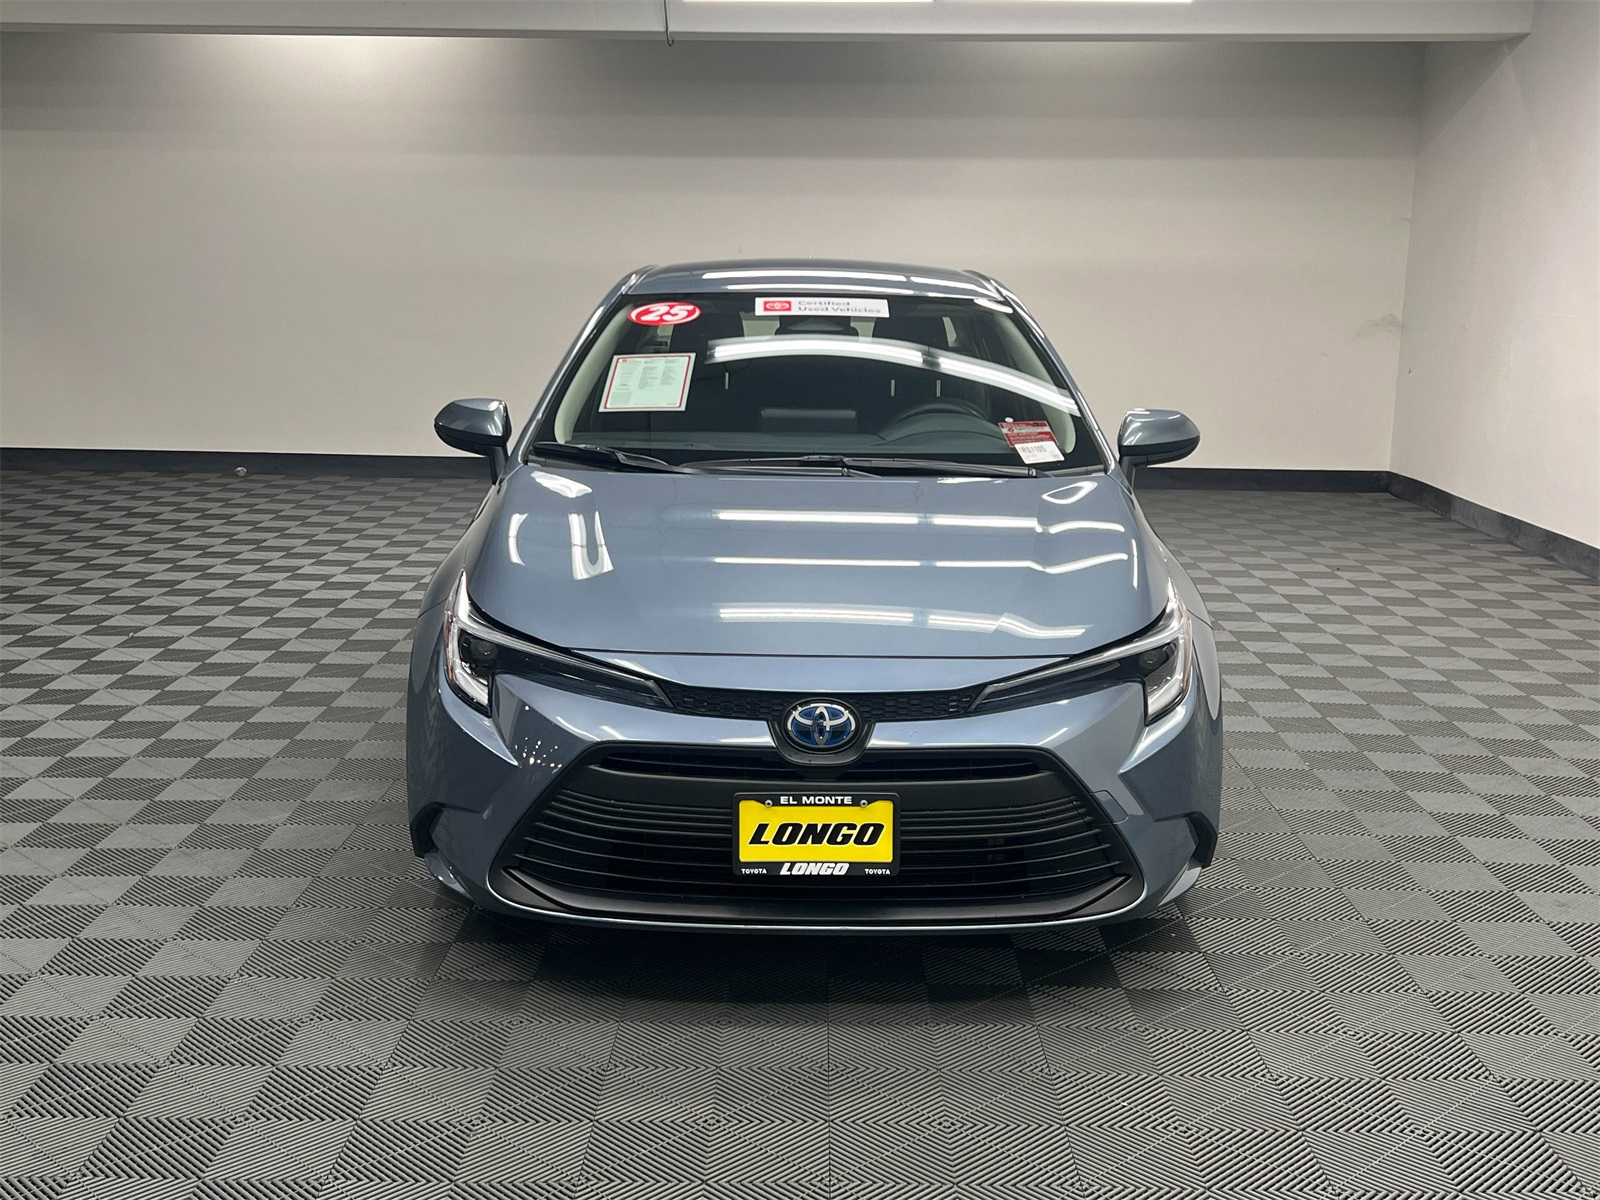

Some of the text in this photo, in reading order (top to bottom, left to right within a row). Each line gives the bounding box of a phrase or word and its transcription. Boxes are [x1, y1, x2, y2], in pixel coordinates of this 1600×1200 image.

[640, 305, 695, 321] 25
[780, 796, 852, 804] EL MONTE
[748, 822, 885, 846] LONGO
[780, 862, 850, 875] LONGO
